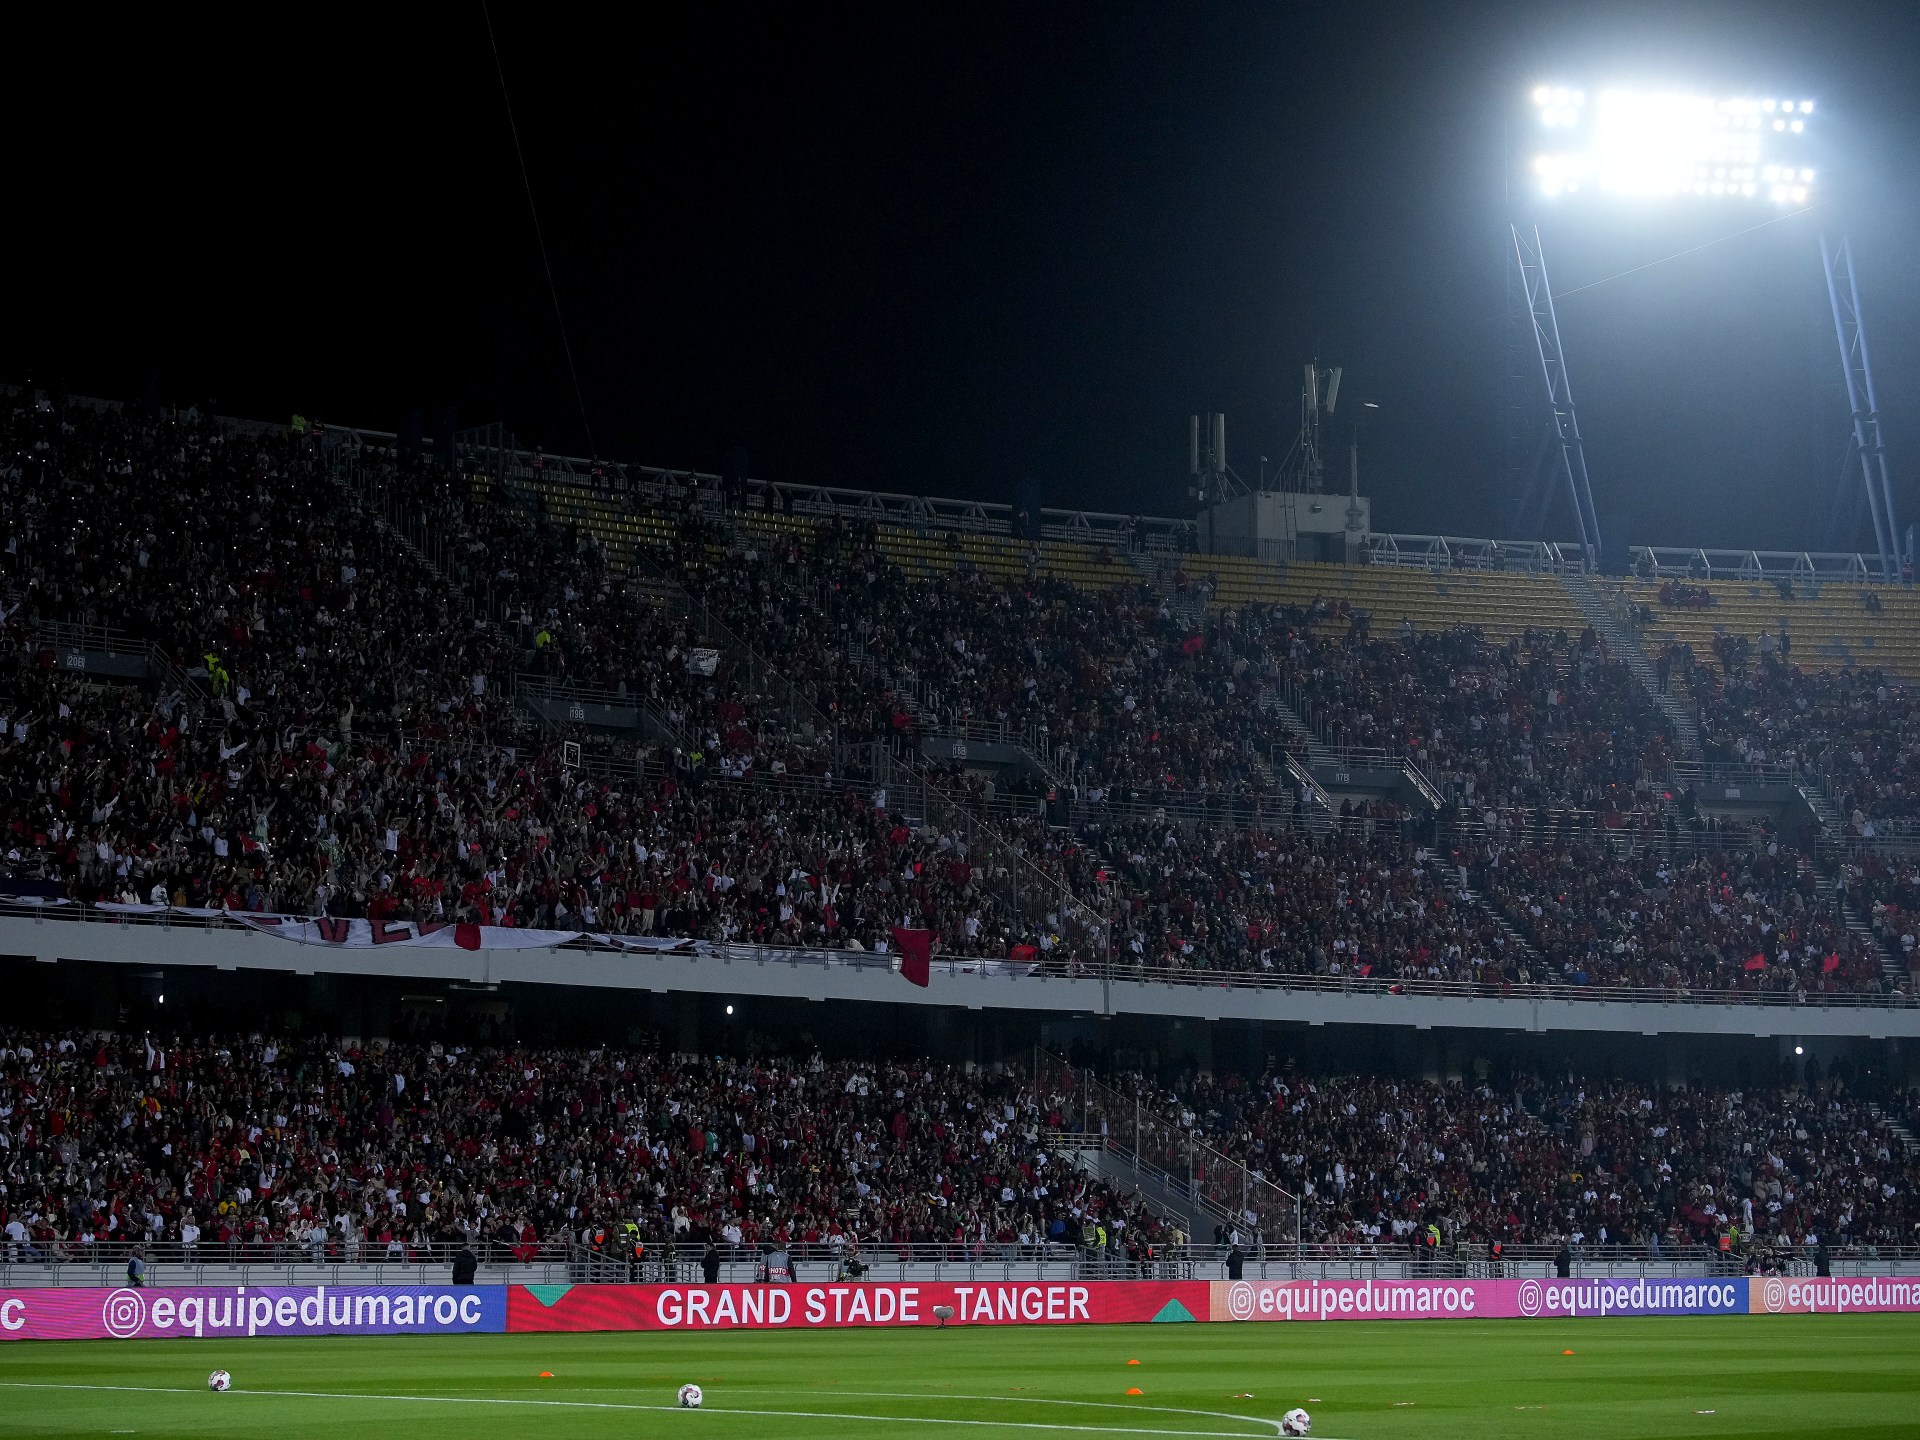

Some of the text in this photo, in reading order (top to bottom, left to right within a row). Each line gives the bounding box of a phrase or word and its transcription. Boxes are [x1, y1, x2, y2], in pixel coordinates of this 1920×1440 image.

[67, 655, 84, 667] 20B
[571, 708, 584, 719] 19B
[152, 1286, 482, 1337] equipedumaroc
[657, 1286, 1090, 1326] GRAND STADE TANGER
[1259, 1281, 1475, 1320] equipedumaroc
[1545, 1279, 1736, 1316] equipedumaroc
